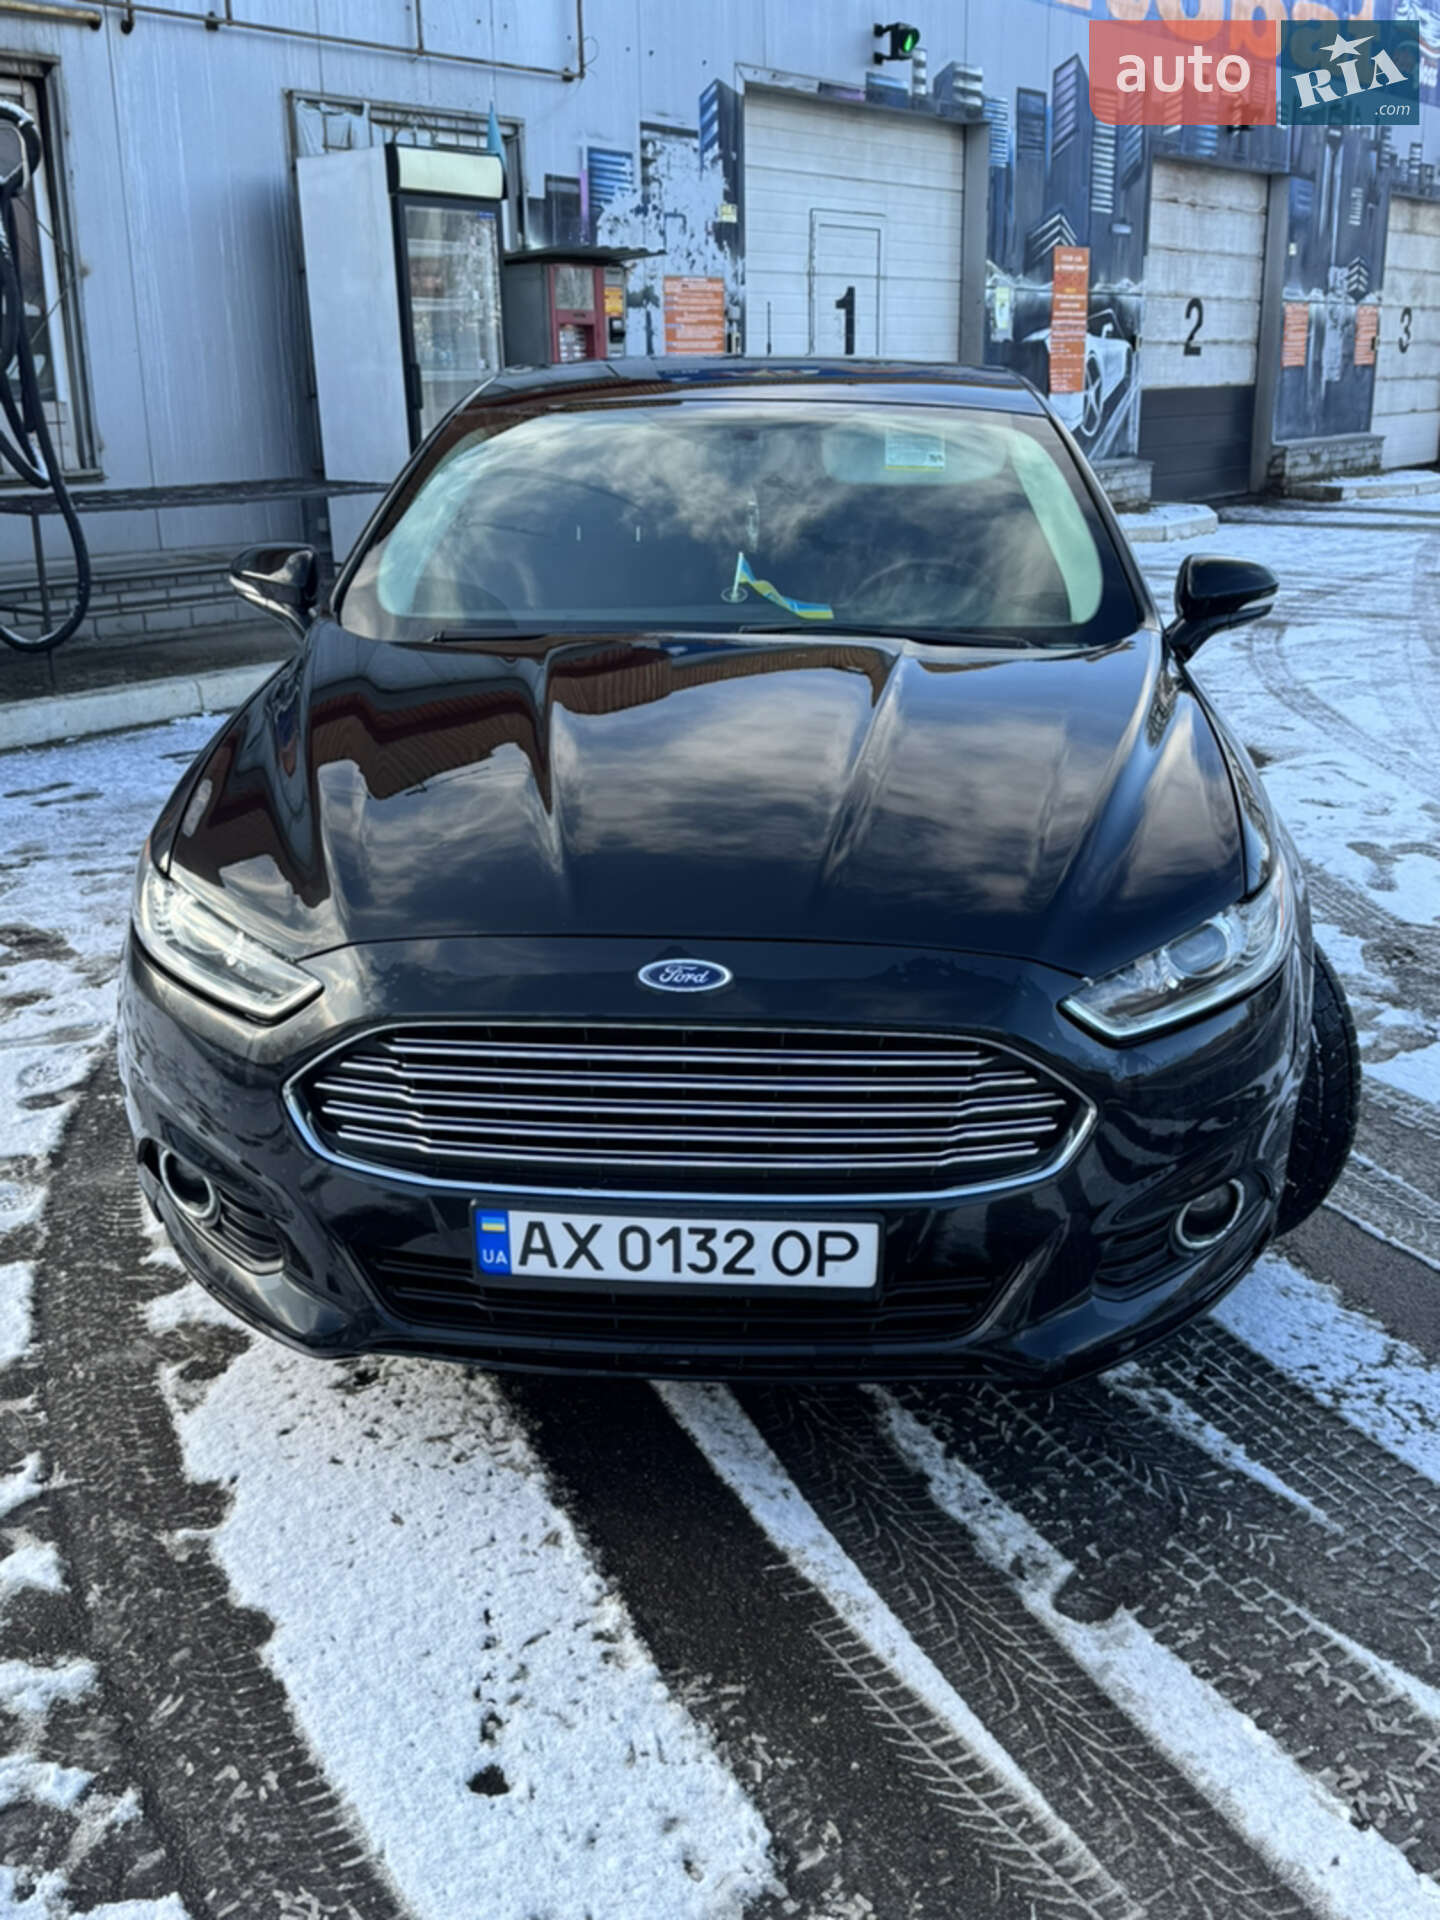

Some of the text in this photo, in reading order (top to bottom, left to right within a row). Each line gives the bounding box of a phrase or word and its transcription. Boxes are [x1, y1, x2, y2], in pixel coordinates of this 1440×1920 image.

[835, 286, 855, 355] 1
[1183, 298, 1203, 356] 2
[1398, 307, 1412, 353] 3
[659, 965, 710, 984] Ford
[482, 1249, 508, 1265] UA
[518, 1220, 860, 1278] AX 0132 OP
